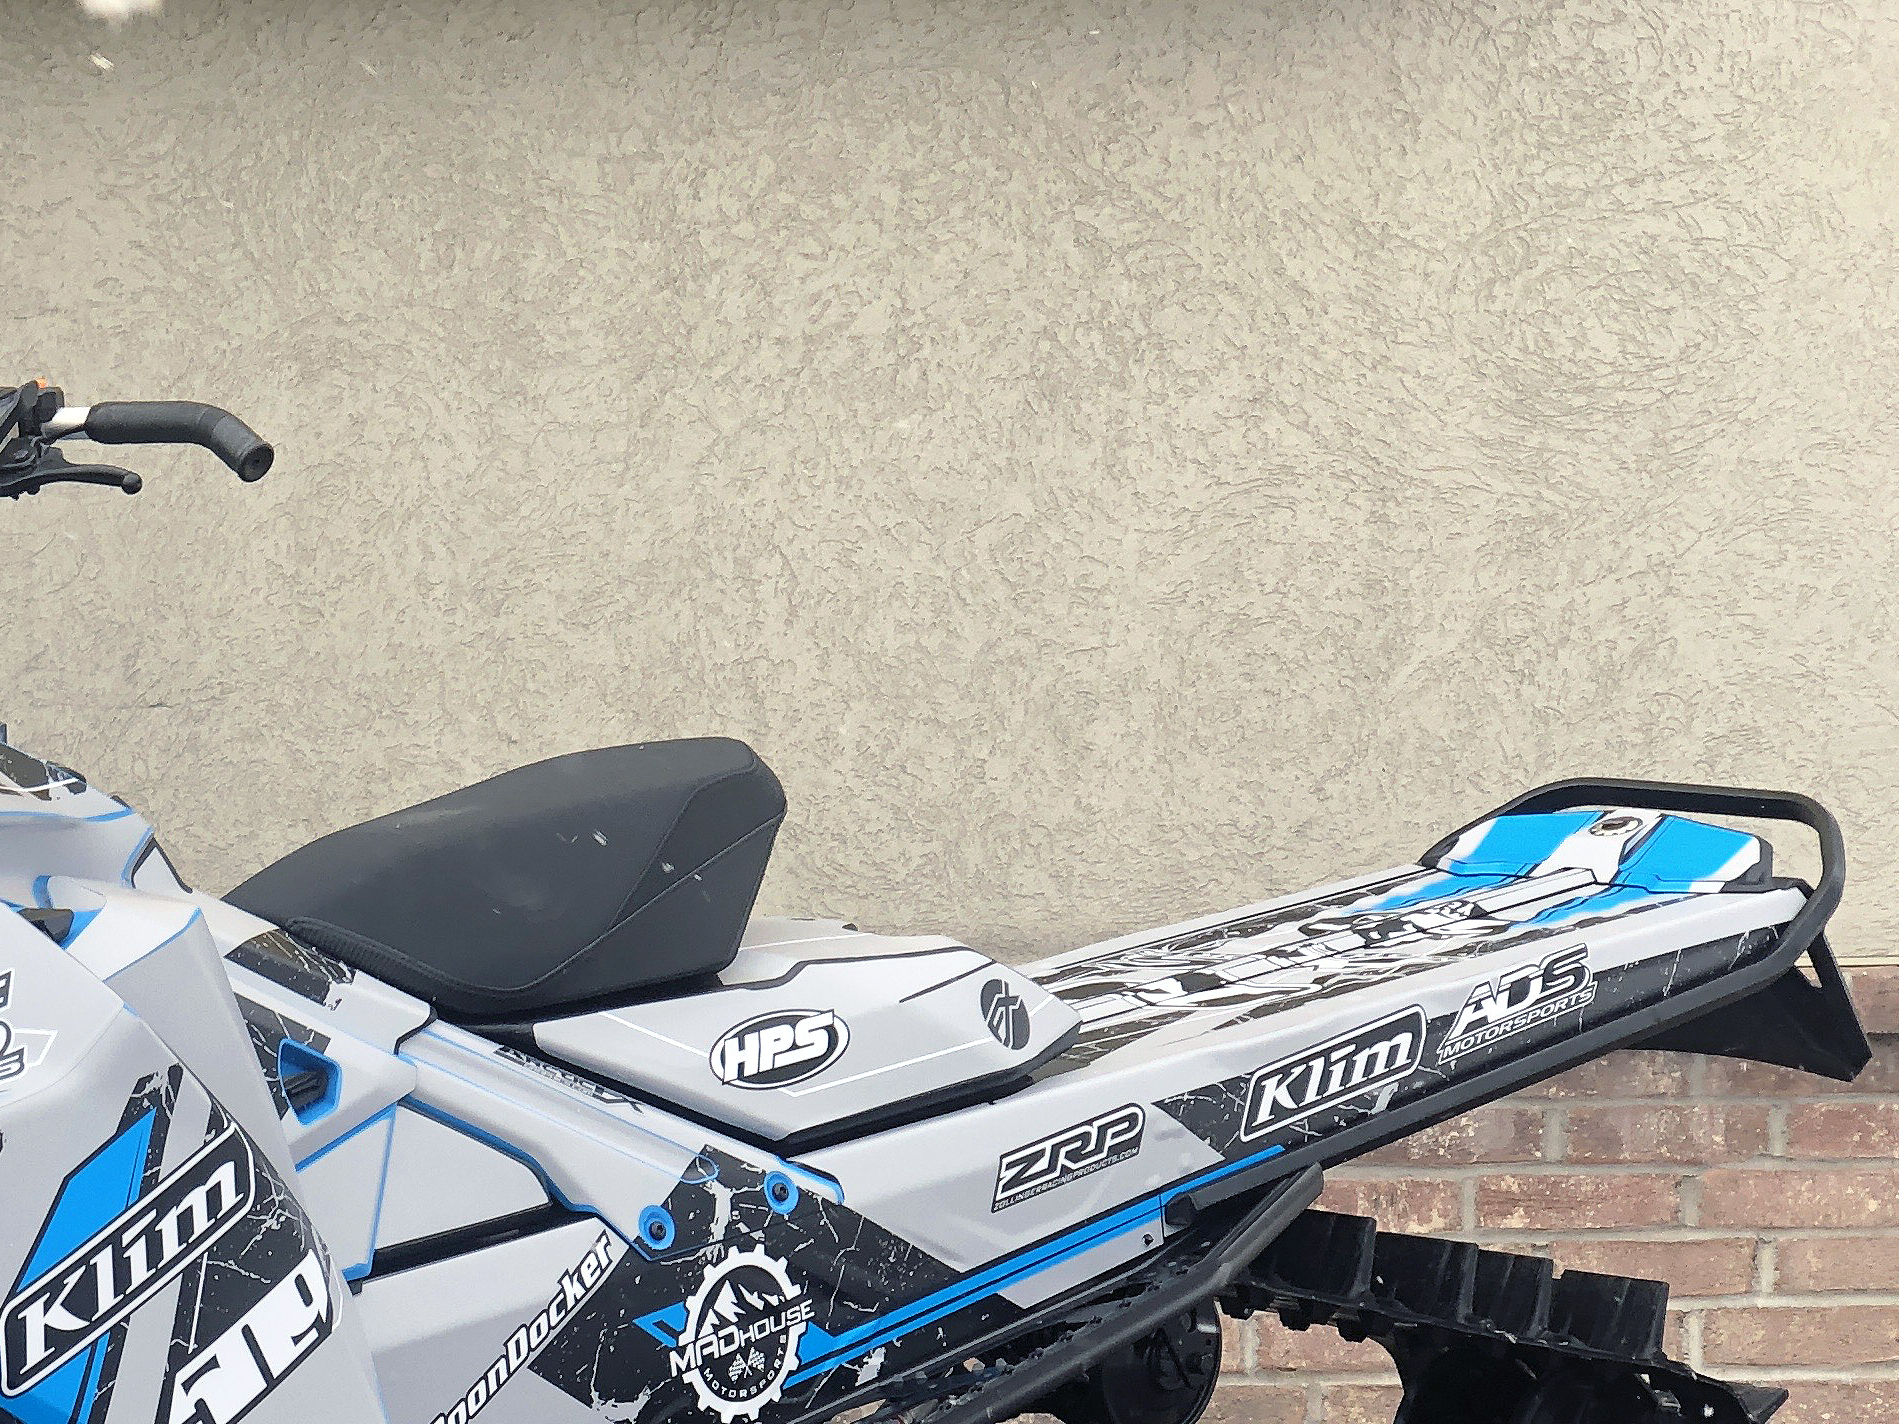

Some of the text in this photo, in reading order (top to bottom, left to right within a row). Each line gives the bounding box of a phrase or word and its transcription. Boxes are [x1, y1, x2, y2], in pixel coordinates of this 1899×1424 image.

[1443, 987, 1594, 1058] MOTORSPORTS
[1447, 942, 1590, 1040] ADS
[723, 1011, 834, 1083] HPS
[1251, 1032, 1413, 1127] Klim
[998, 1106, 1143, 1201] ZRP
[18, 1161, 244, 1374] Klim
[703, 1334, 787, 1398] MOTORSPORTS
